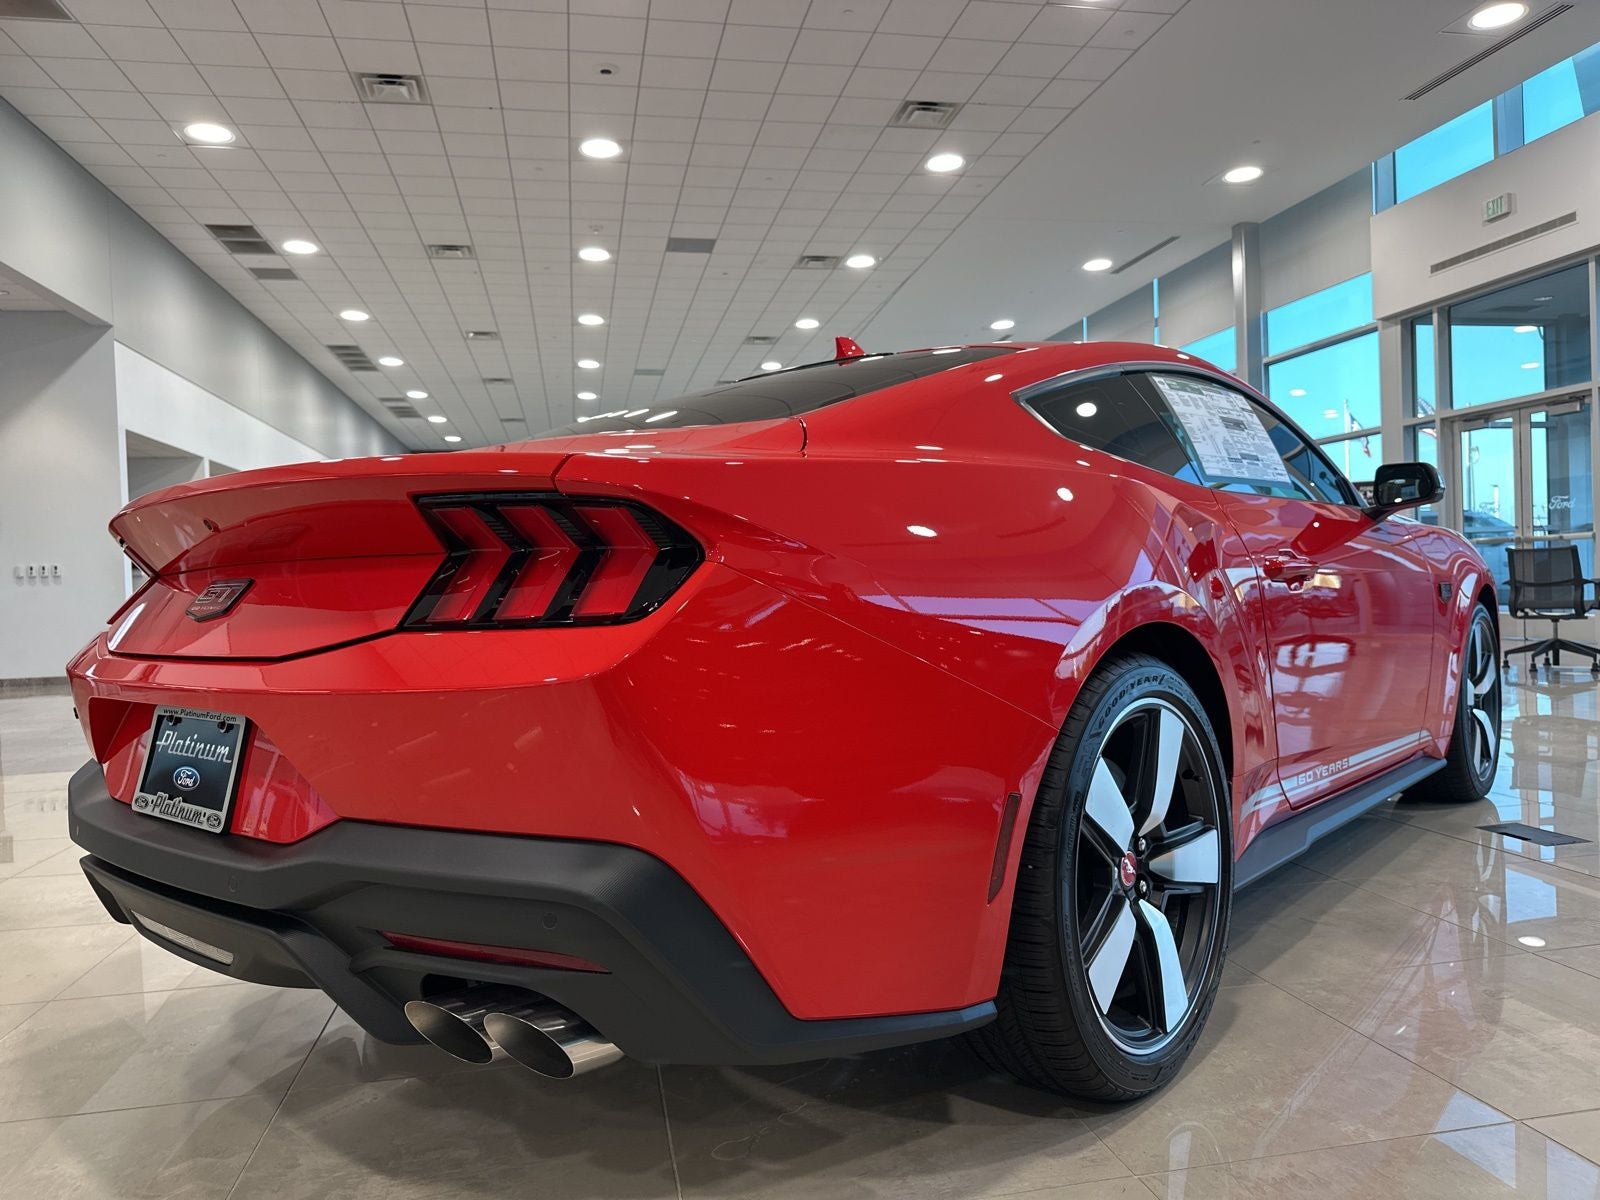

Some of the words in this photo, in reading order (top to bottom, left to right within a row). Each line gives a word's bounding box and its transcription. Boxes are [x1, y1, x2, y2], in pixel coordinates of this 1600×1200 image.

[1486, 195, 1504, 219] EXIT
[1549, 495, 1576, 510] Ford
[1098, 675, 1159, 729] GOODYEAR
[163, 708, 237, 722] www.PlatinumFord.com
[156, 730, 232, 763] Platinum
[177, 769, 195, 787] Ford
[1298, 770, 1314, 785] 60
[1315, 758, 1349, 779] YEARS
[151, 793, 204, 825] Platinum
